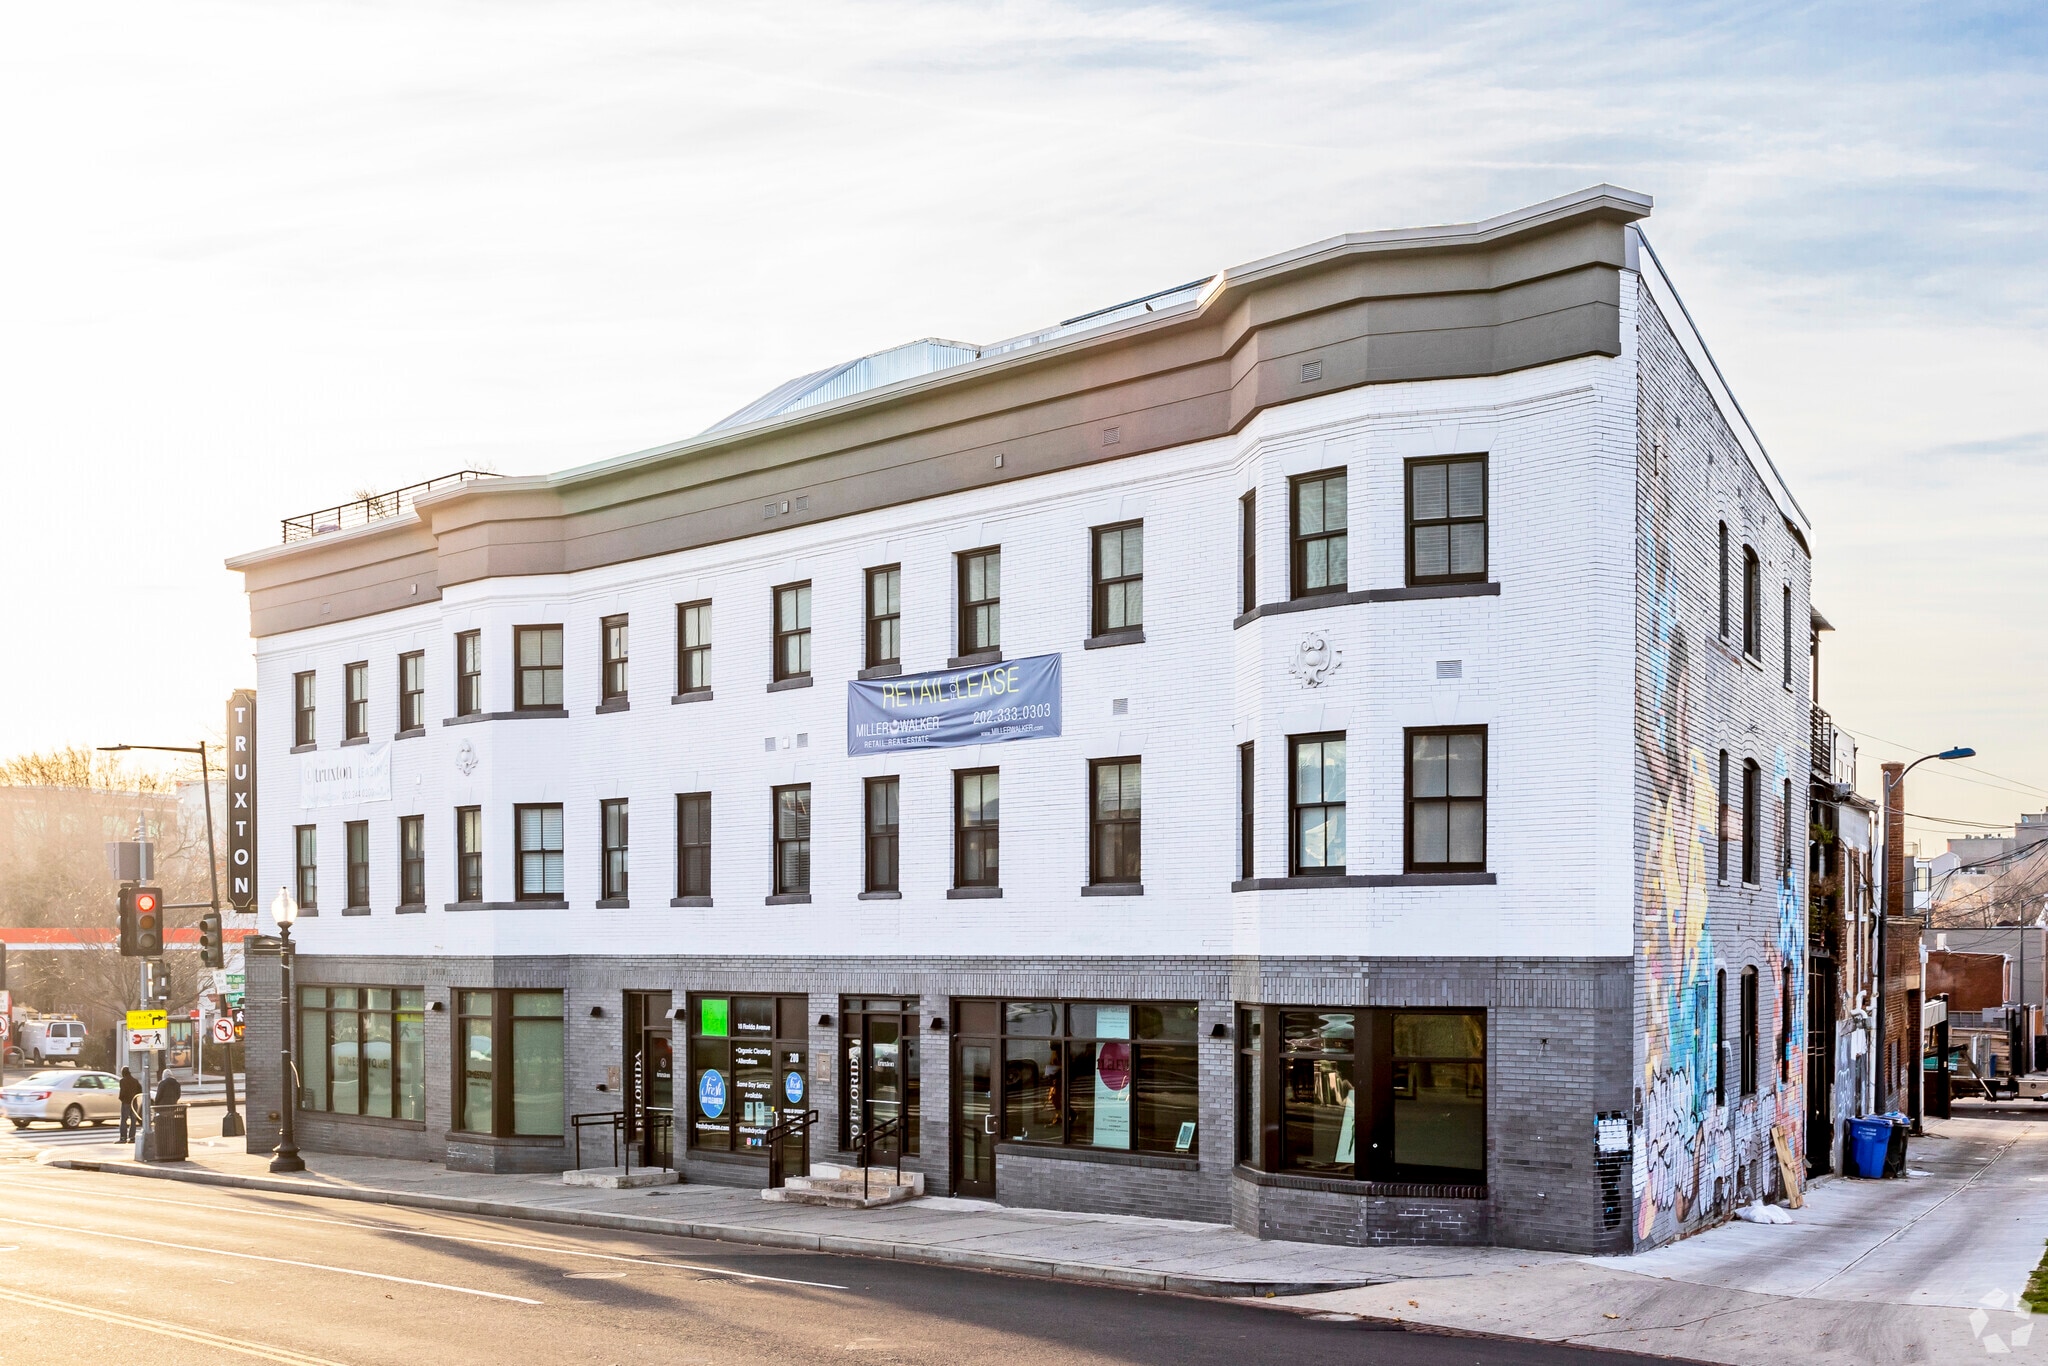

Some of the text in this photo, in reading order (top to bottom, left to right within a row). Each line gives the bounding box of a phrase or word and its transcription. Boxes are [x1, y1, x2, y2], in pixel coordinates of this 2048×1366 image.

[882, 677, 950, 709] RETAIL
[956, 666, 1019, 699] LEASE
[973, 702, 1051, 725] 202.333.0303
[856, 716, 940, 737] MILLER WALKER
[864, 735, 929, 748] RETAIL REAL ESTATE
[316, 766, 352, 783] truxton
[234, 707, 249, 893] TRUXTON
[634, 1050, 642, 1118] FLORIDA
[702, 1075, 722, 1096] Fresh
